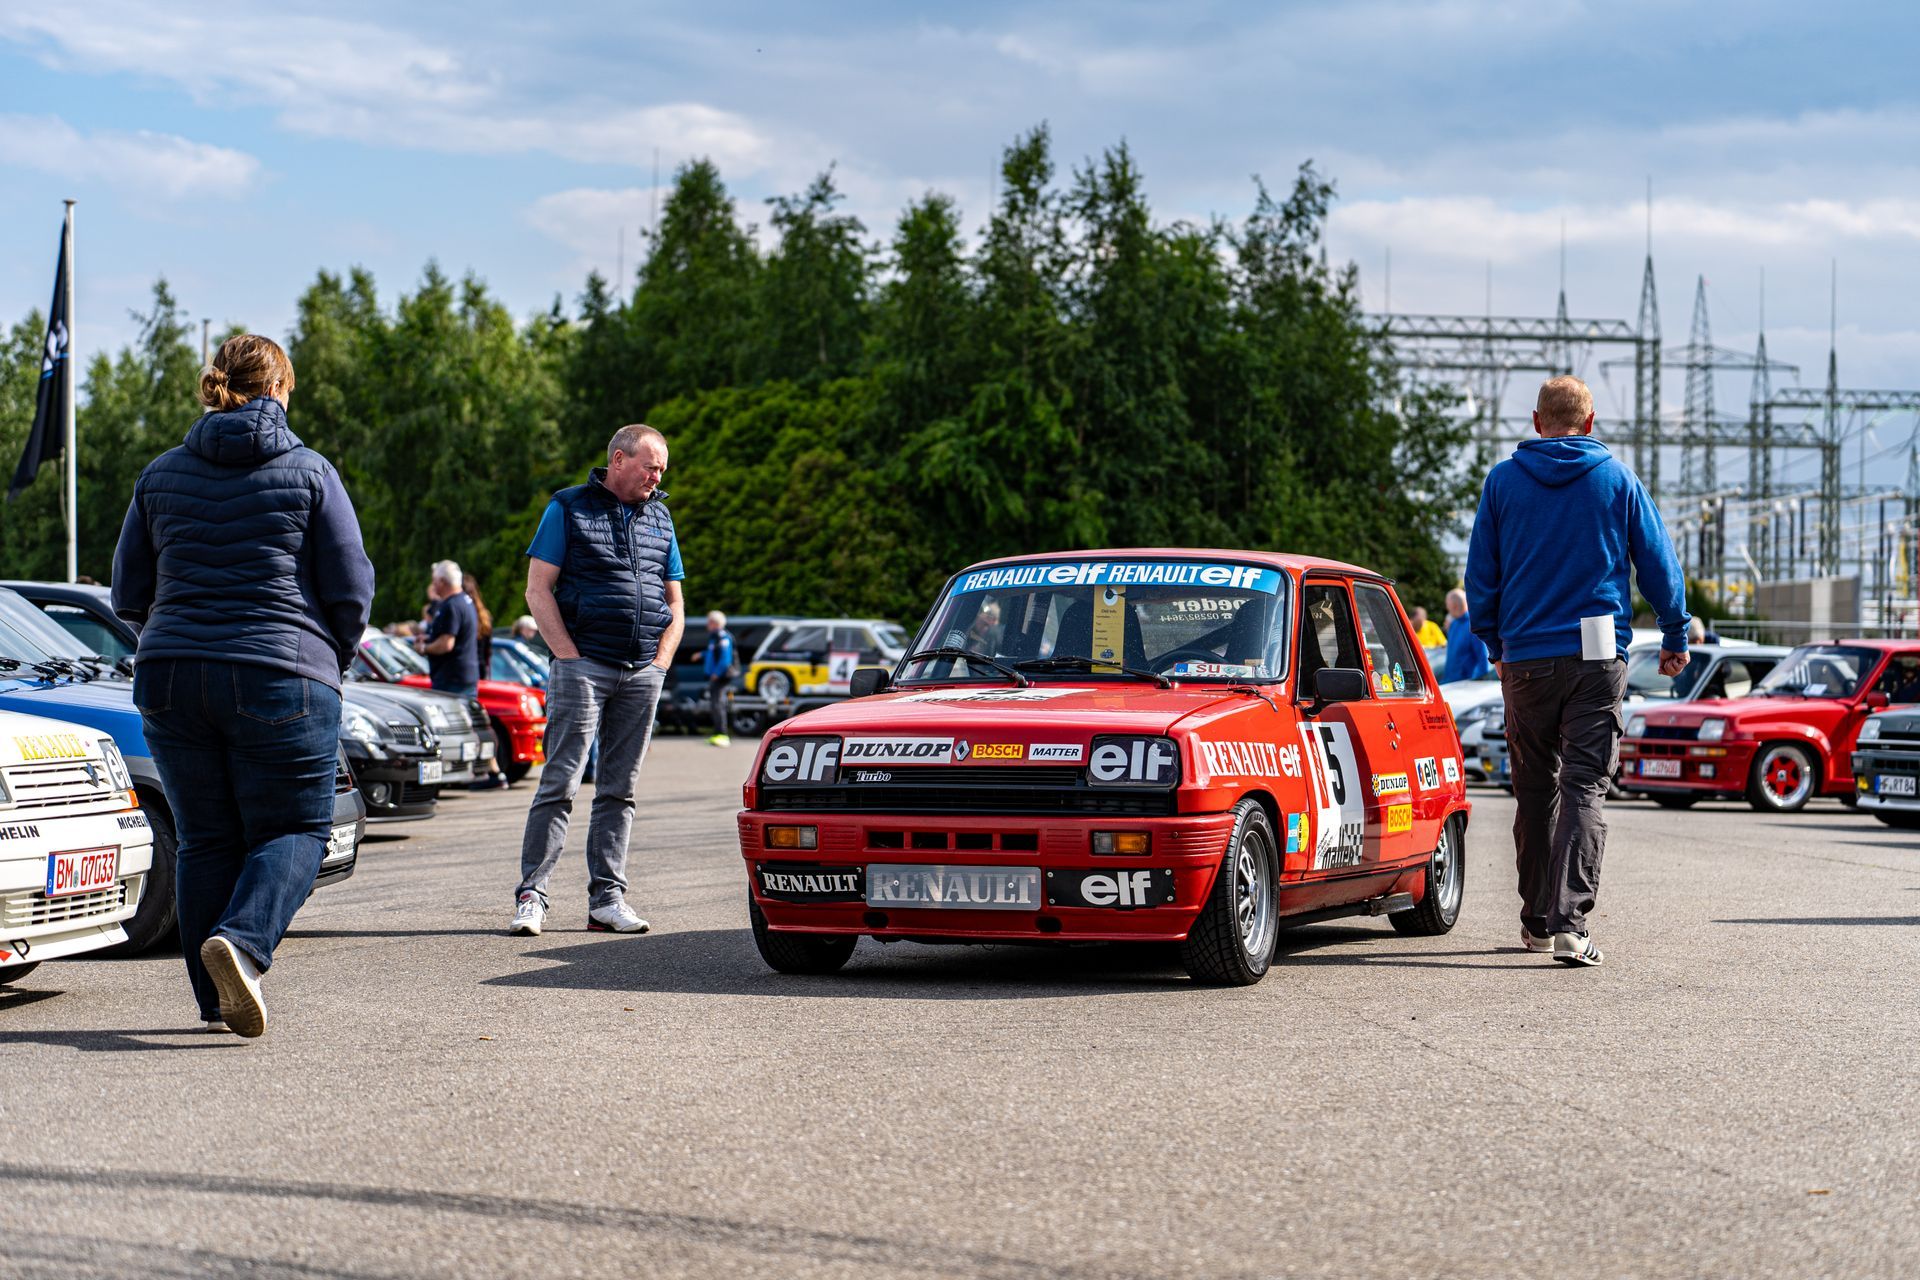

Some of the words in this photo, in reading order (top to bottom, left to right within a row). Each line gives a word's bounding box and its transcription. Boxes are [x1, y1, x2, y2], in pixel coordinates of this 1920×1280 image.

[963, 567, 1050, 591] RENAULT
[1049, 563, 1108, 585] elf
[1107, 565, 1203, 584] RENAULT
[1200, 566, 1263, 589] elf
[836, 657, 849, 679] 4
[1196, 664, 1220, 673] SU
[766, 742, 840, 781] elf
[844, 743, 952, 757] DUNLOP
[975, 744, 1022, 757] BOSCH
[1032, 747, 1079, 757] MATTER
[1090, 741, 1172, 780] elf
[1201, 741, 1280, 777] RENAULT
[1279, 744, 1302, 777] elf
[857, 771, 891, 782] Turbo
[1319, 727, 1346, 805] 5
[1424, 758, 1438, 787] elf
[1380, 777, 1408, 791] DUNLOP
[1389, 807, 1411, 828] BOSCH
[56, 858, 74, 889] BM
[80, 853, 115, 886] 07033
[763, 872, 858, 893] RENAULT
[870, 870, 1037, 904] RENAULT
[1080, 871, 1151, 905] elf
